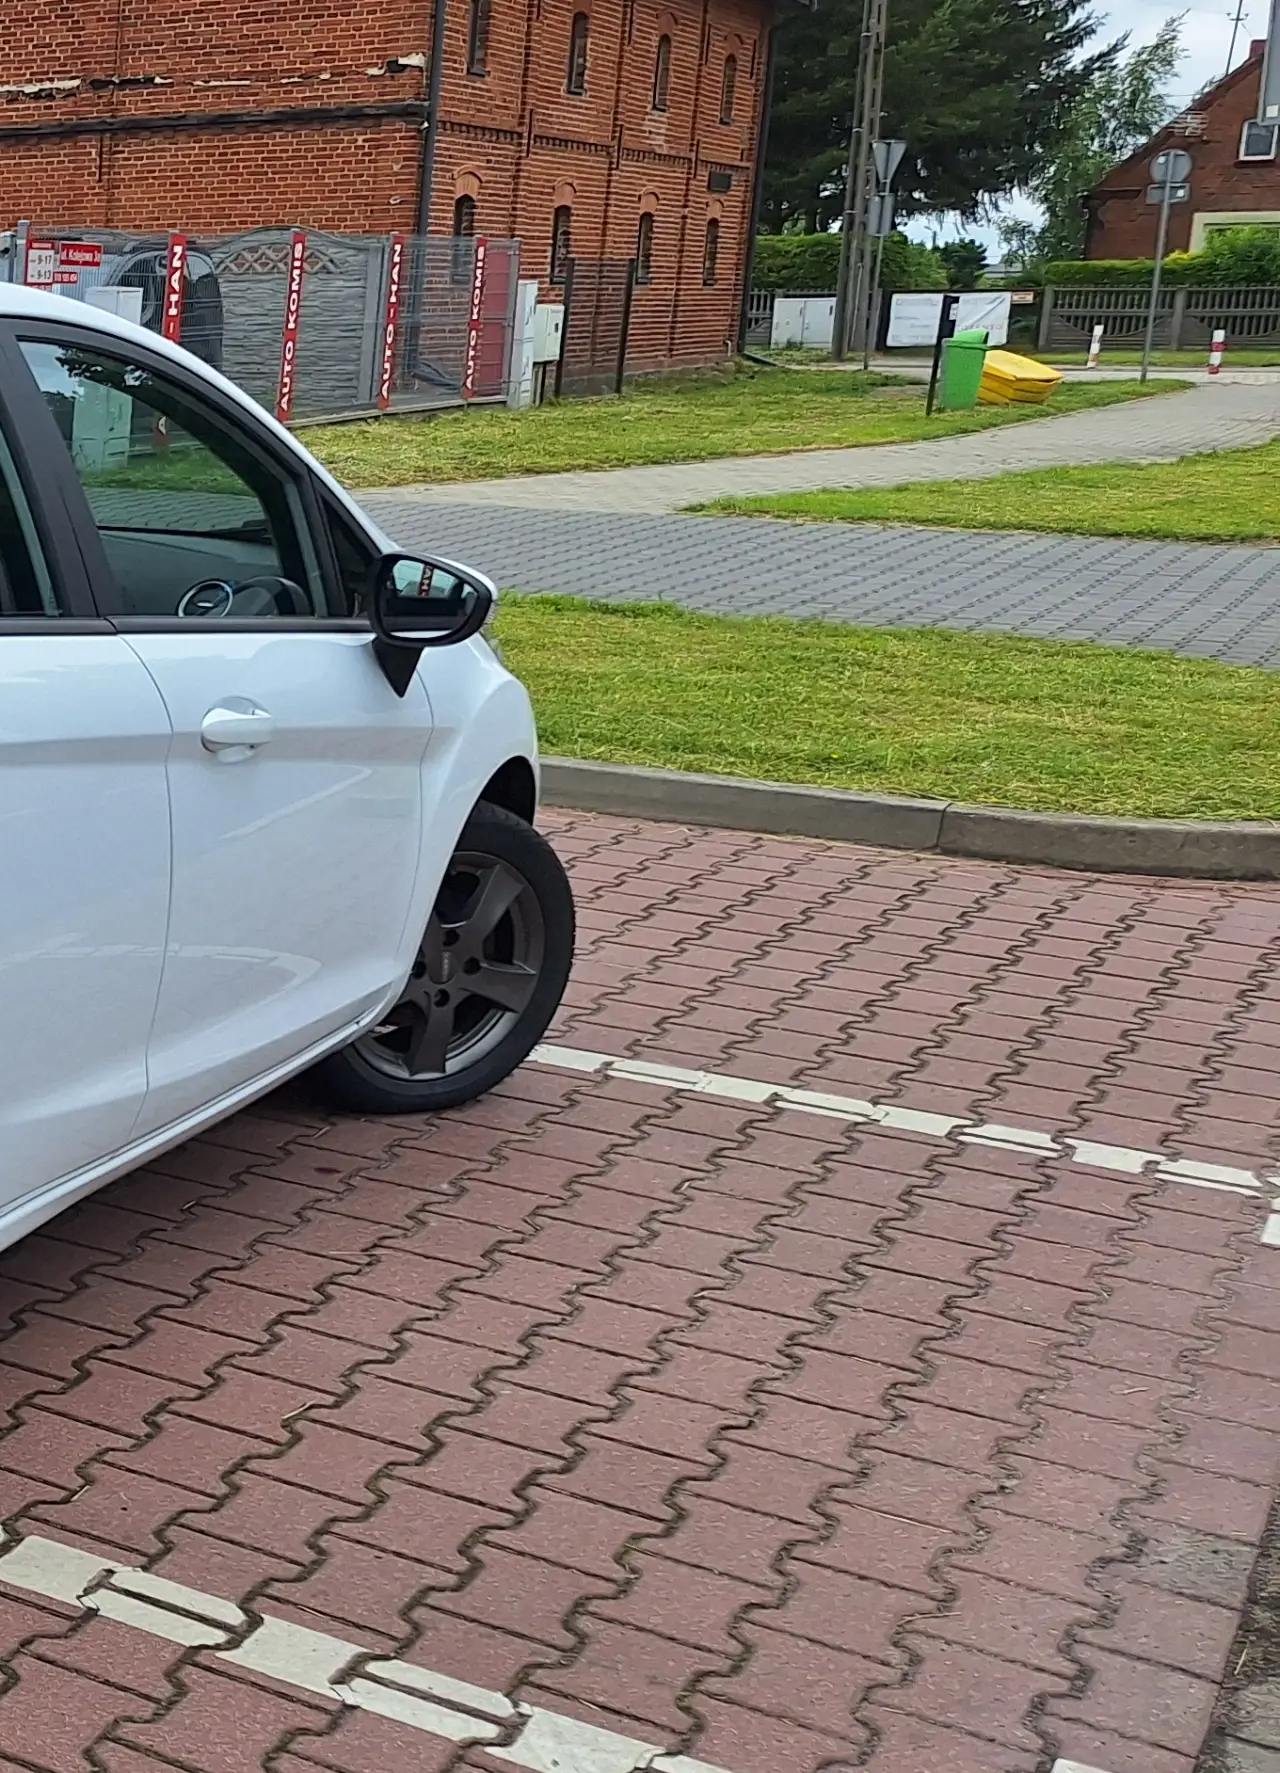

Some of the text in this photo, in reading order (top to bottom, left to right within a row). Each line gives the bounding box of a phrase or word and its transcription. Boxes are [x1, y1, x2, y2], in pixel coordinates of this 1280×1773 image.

[280, 242, 303, 411] AUTO KOMIS
[466, 246, 485, 390] AUTO KOMIS
